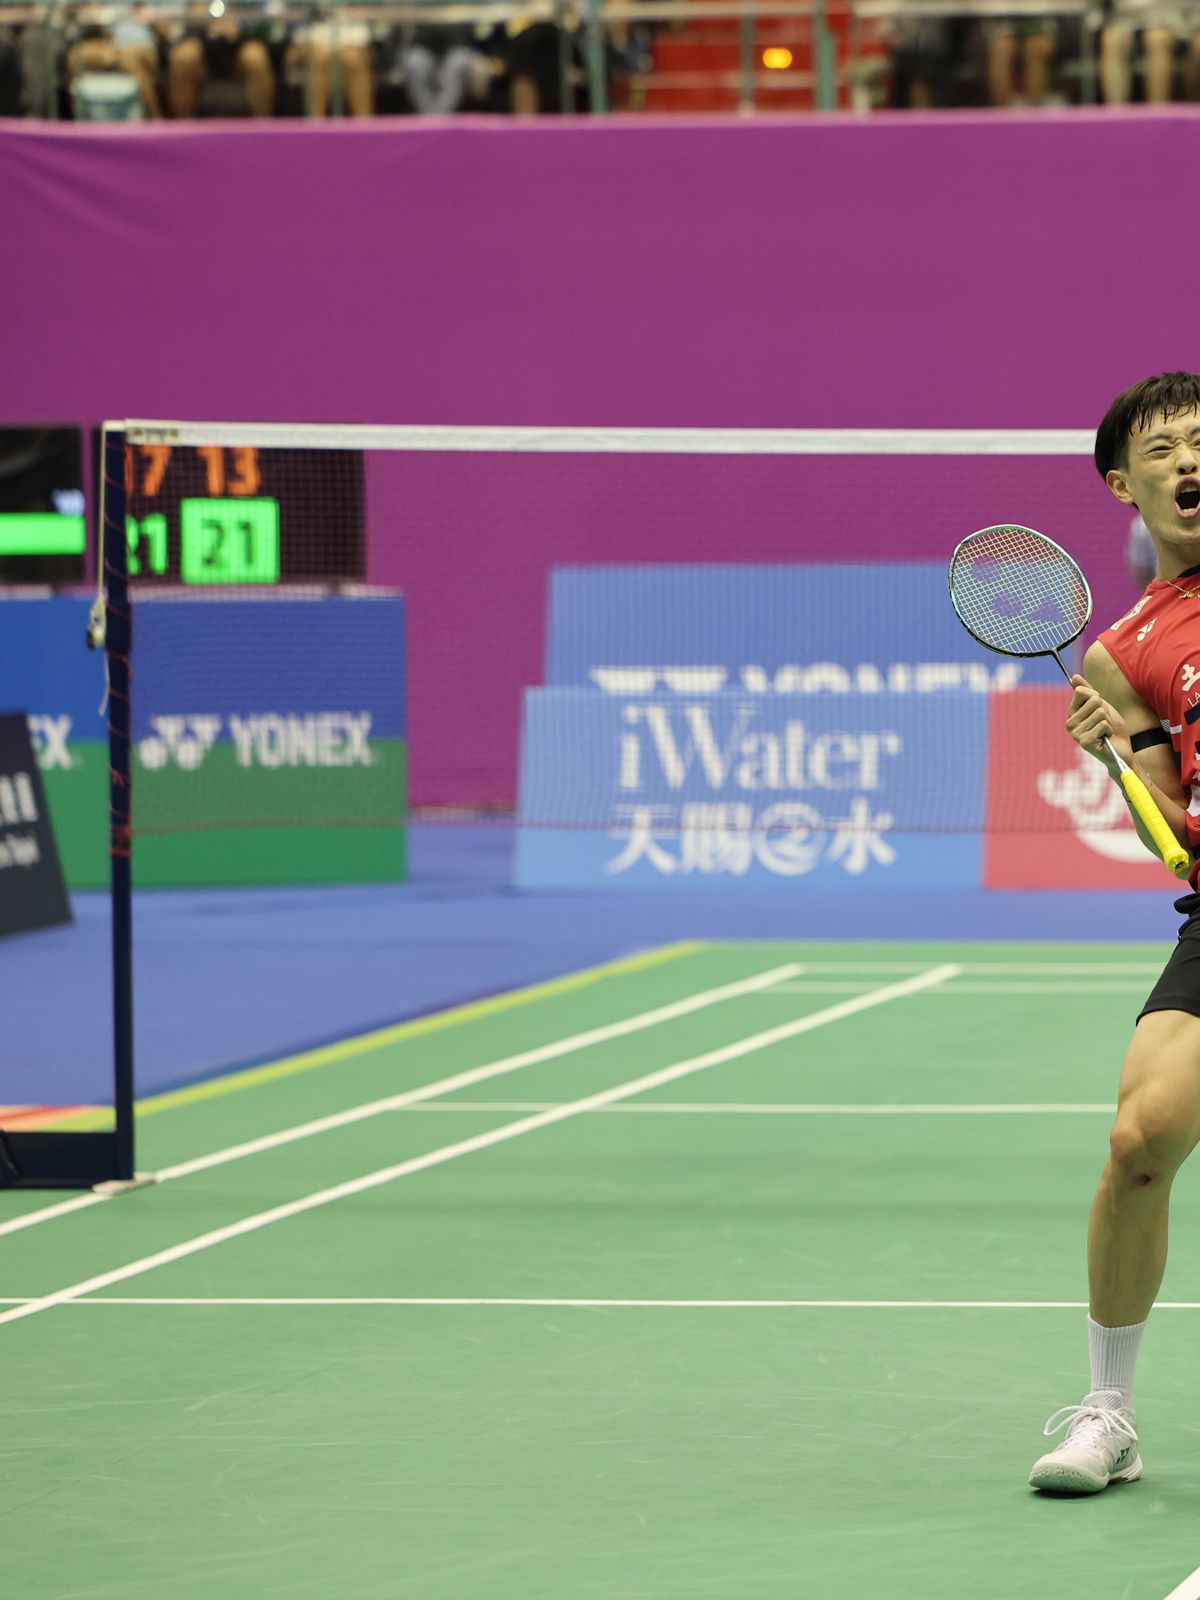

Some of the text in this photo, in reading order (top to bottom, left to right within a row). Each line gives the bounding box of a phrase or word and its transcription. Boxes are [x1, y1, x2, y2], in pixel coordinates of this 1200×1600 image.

[202, 518, 255, 568] 21
[228, 710, 373, 769] YONEX
[617, 701, 904, 791] iWater
